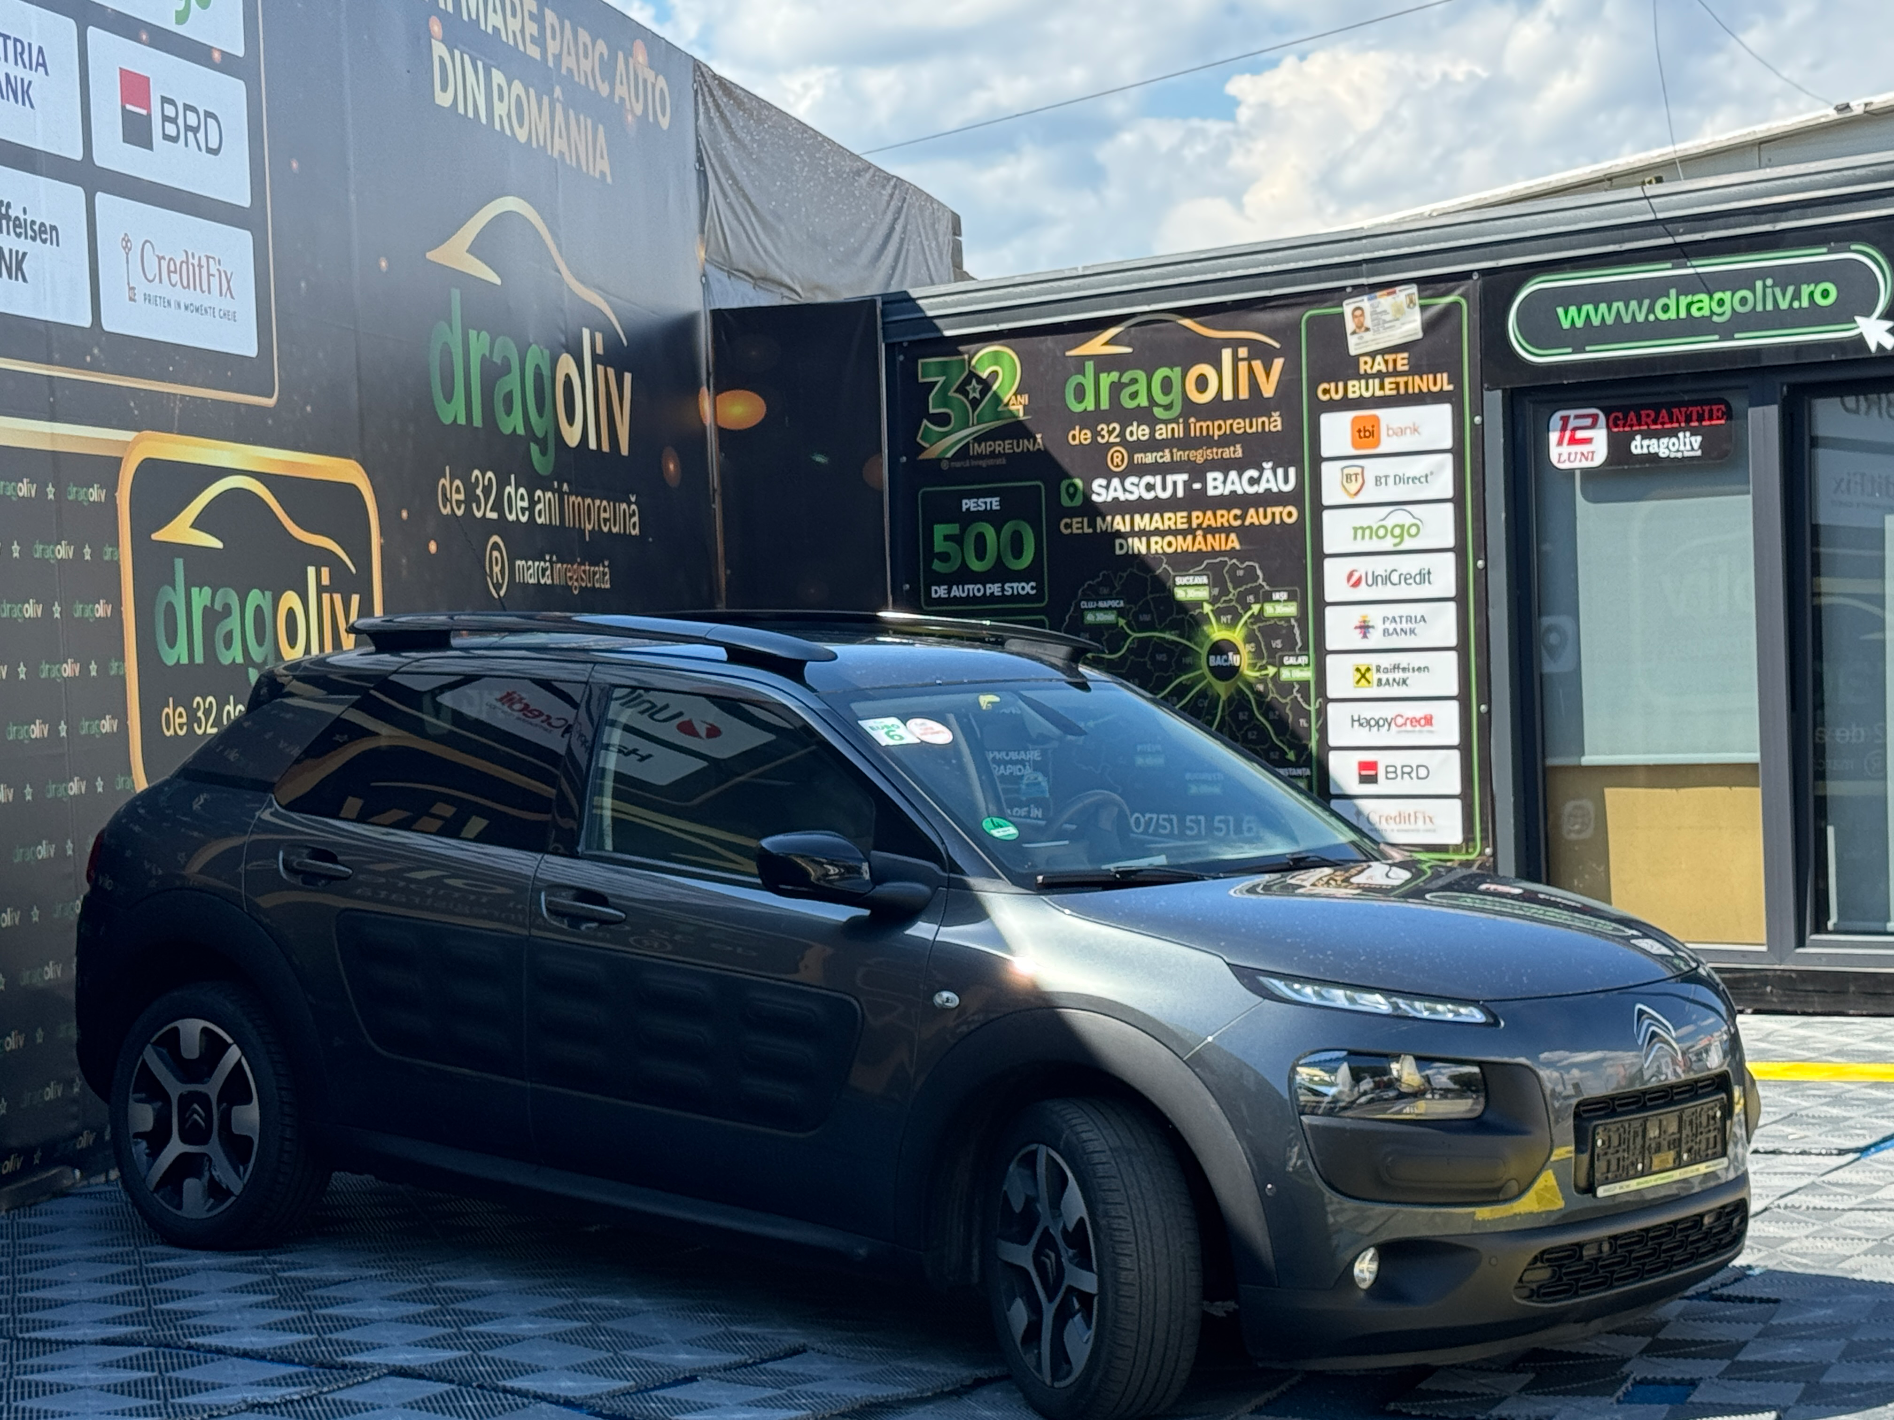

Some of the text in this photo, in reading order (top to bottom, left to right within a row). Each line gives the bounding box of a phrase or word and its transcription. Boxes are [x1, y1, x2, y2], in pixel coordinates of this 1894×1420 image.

[0, 32, 49, 77] TRIA
[545, 7, 610, 98] PARC
[614, 50, 671, 130] AUTO
[431, 38, 613, 184] DIN ROMÂNIA
[160, 95, 224, 157] BRD
[140, 239, 235, 300] CreditFix
[143, 292, 172, 309] PRIETEN
[183, 301, 217, 319] MOMENTE
[1556, 278, 1838, 330] www.dragoliv.ro
[1358, 352, 1409, 375] RATE
[428, 288, 633, 477] dragoliv
[1064, 347, 1285, 420] dragoliv
[1316, 372, 1454, 401] CU BULETINUL
[917, 345, 1021, 448] 32
[1009, 393, 1029, 406] ANI
[1067, 411, 1282, 446] de 32 de ani împreună
[1608, 404, 1728, 429] GARANTIE
[1356, 421, 1421, 439] tbi bank
[1556, 413, 1600, 447] 12
[969, 433, 1045, 456] ÎMPREUNĂ
[1133, 448, 1172, 464] marcă
[1173, 444, 1243, 465] înregistrată
[1557, 450, 1596, 464] LUNI
[1630, 431, 1702, 458] dragoliv
[1091, 473, 1189, 503] SASCUT
[1206, 461, 1297, 497] BACĂU
[1345, 472, 1360, 484] BT
[1374, 474, 1390, 487] BT
[67, 482, 106, 506] dragoliv
[437, 465, 640, 542] de 32 de ani împreună
[962, 497, 1001, 512] PESTE
[1059, 505, 1299, 535] CEL MAI MARE PARC AUTO
[1114, 530, 1241, 556] DIN ROMÂNIA
[1352, 521, 1421, 547] mogo
[33, 540, 74, 563] dragoliv
[931, 520, 1035, 574] 500
[515, 554, 551, 585] marcă
[552, 555, 611, 595] înregistrată
[1365, 567, 1432, 587] UniCredit
[931, 582, 1037, 599] DE AUTO PE STOC
[73, 599, 112, 622] dragoliv
[1080, 600, 1124, 609] CLUJ-NAPOCA
[154, 557, 360, 687] dragoliv
[1382, 614, 1427, 626] PATRIA
[1382, 627, 1417, 637] BANK
[39, 658, 80, 683] dragoliv
[1209, 652, 1240, 667] BACĂU
[1375, 663, 1430, 674] Raiffeisen
[1376, 677, 1409, 687] BANK
[6, 714, 118, 743] dragoliv dragoliv
[161, 696, 188, 737] de
[192, 695, 218, 736] 32
[1351, 713, 1433, 732] HappyCredit
[885, 730, 905, 742] 6
[1384, 764, 1430, 781] BRD
[46, 776, 86, 802] dragoliv
[1130, 813, 1178, 835] 0751
[1185, 815, 1205, 836] 51
[1214, 816, 1234, 836] 51
[1367, 810, 1435, 826] CreditFix
[13, 840, 55, 864] dragoliv
